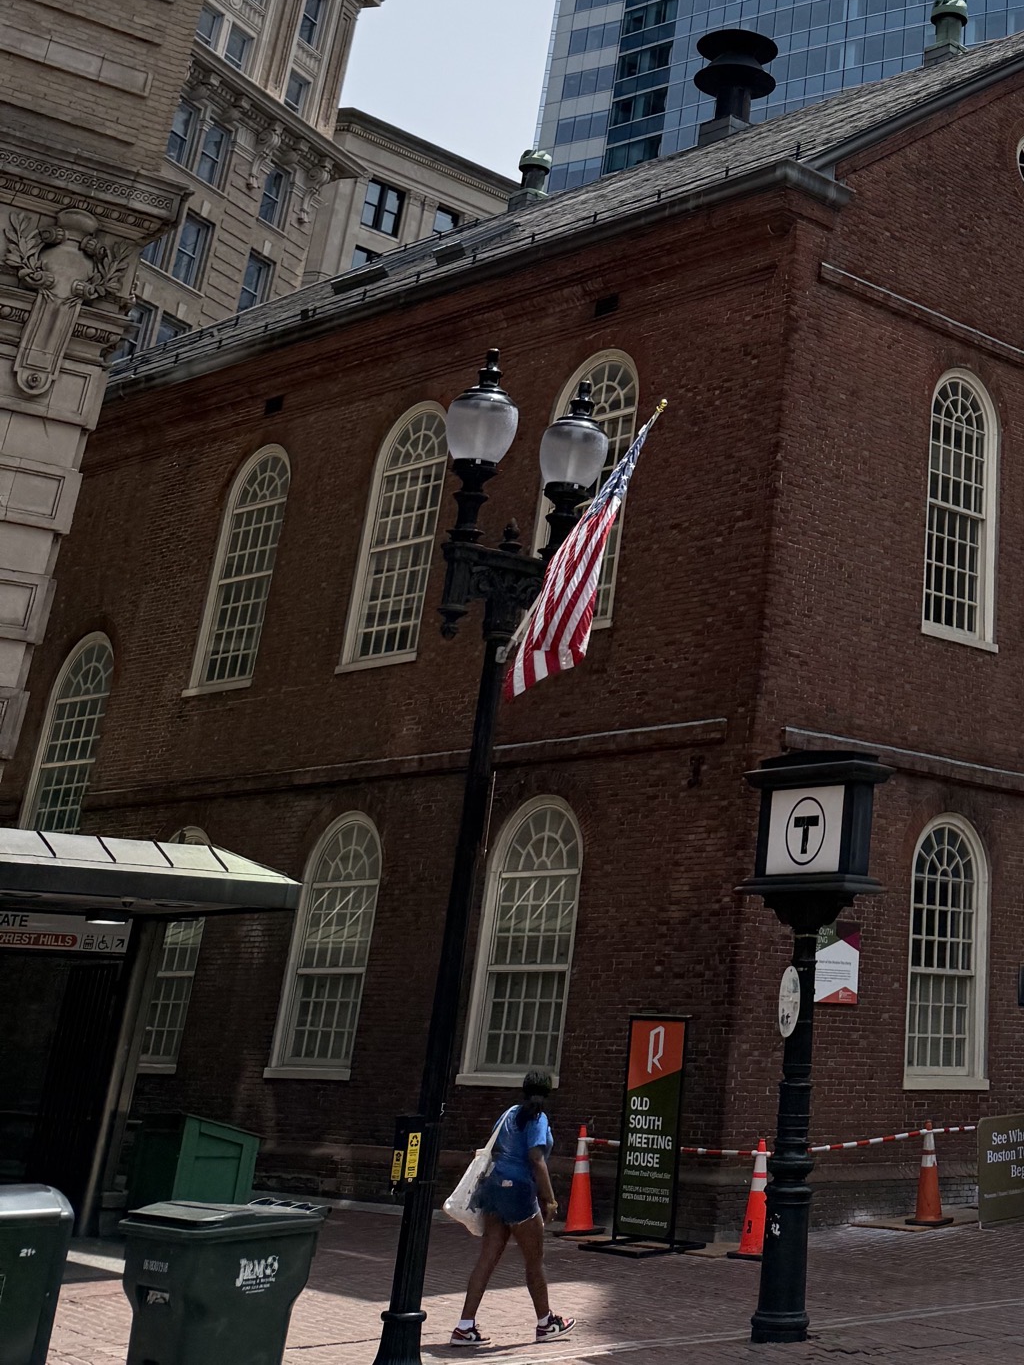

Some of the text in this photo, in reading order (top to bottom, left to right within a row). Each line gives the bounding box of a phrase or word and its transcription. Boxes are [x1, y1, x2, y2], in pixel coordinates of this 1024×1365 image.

[794, 815, 819, 854] T
[0, 914, 29, 927] ATE
[39, 934, 73, 946] HILLS
[630, 1096, 650, 1110] OLD
[629, 1115, 662, 1130] SOUTH
[627, 1133, 672, 1150] MEETING
[991, 1132, 1008, 1146] See
[626, 1151, 660, 1167] HOUSE
[987, 1149, 1016, 1163] Boston
